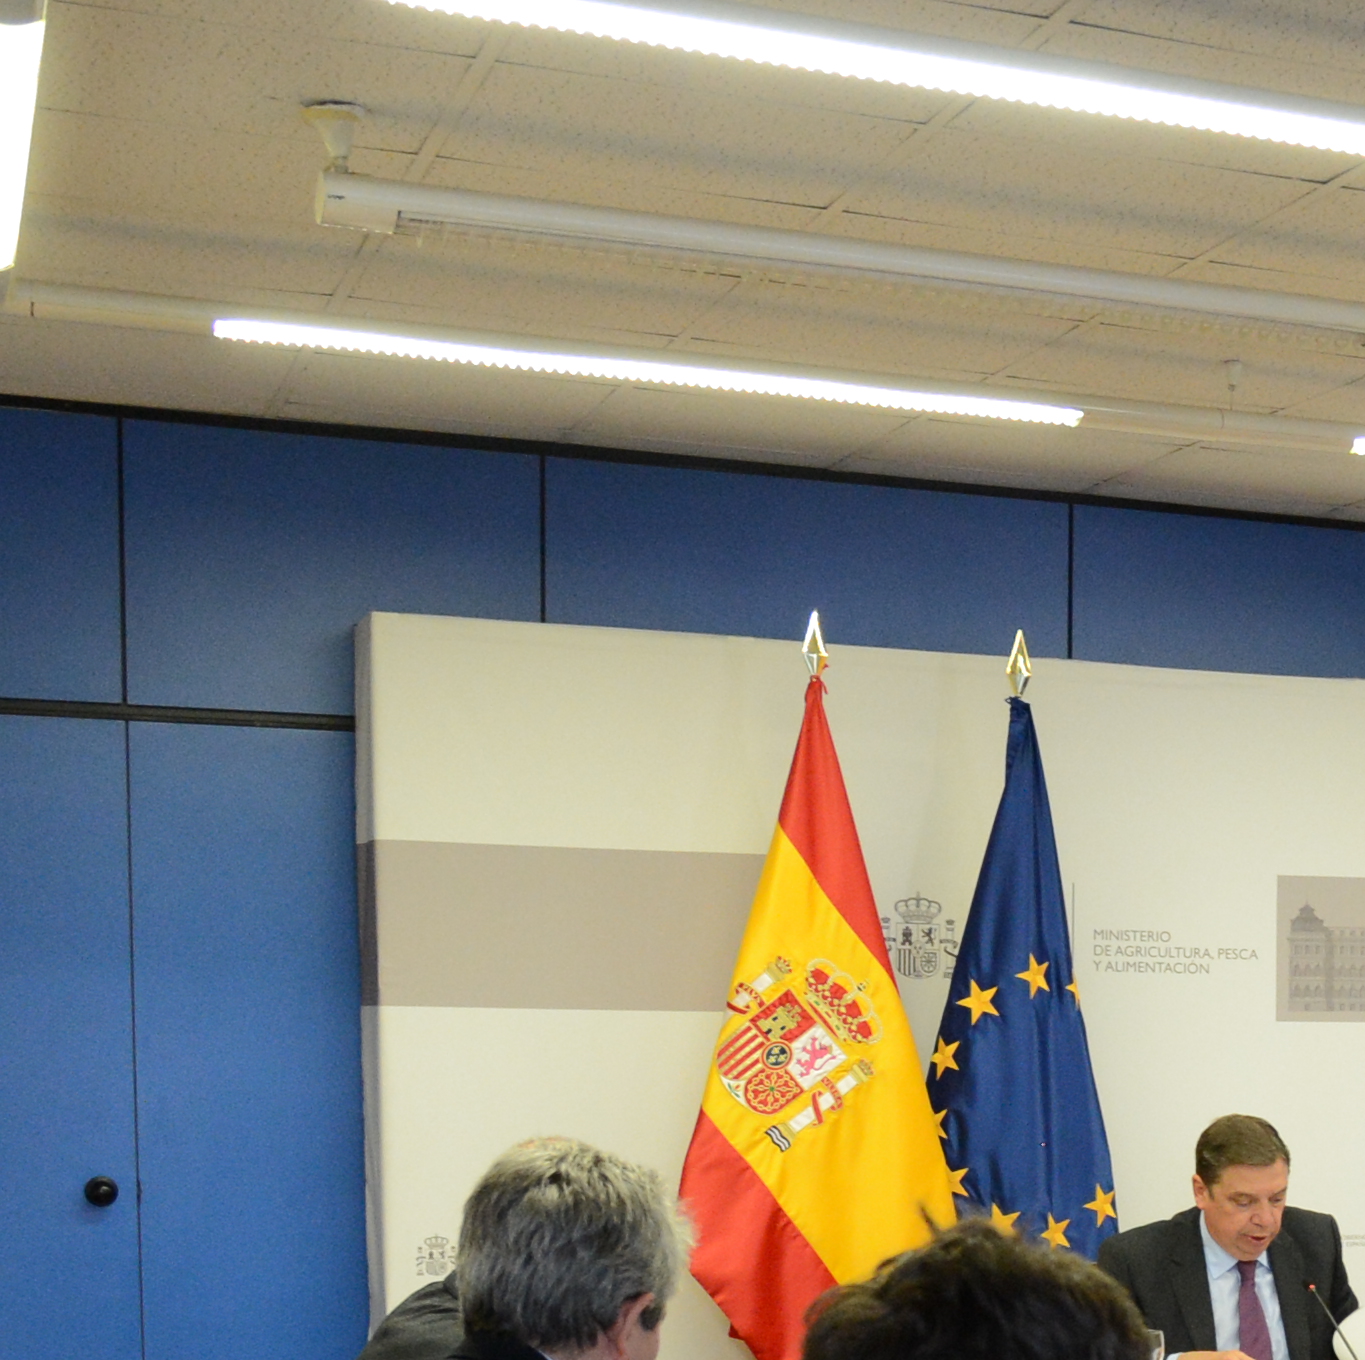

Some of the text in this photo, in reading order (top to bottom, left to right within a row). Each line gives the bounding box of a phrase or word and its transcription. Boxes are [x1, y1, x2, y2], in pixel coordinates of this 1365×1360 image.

[1093, 929, 1172, 943] MINISTERIO
[1093, 945, 1259, 960] DE AGRICULTURA, PESCA
[1093, 960, 1210, 975] Y ALIMENTACIÓN
